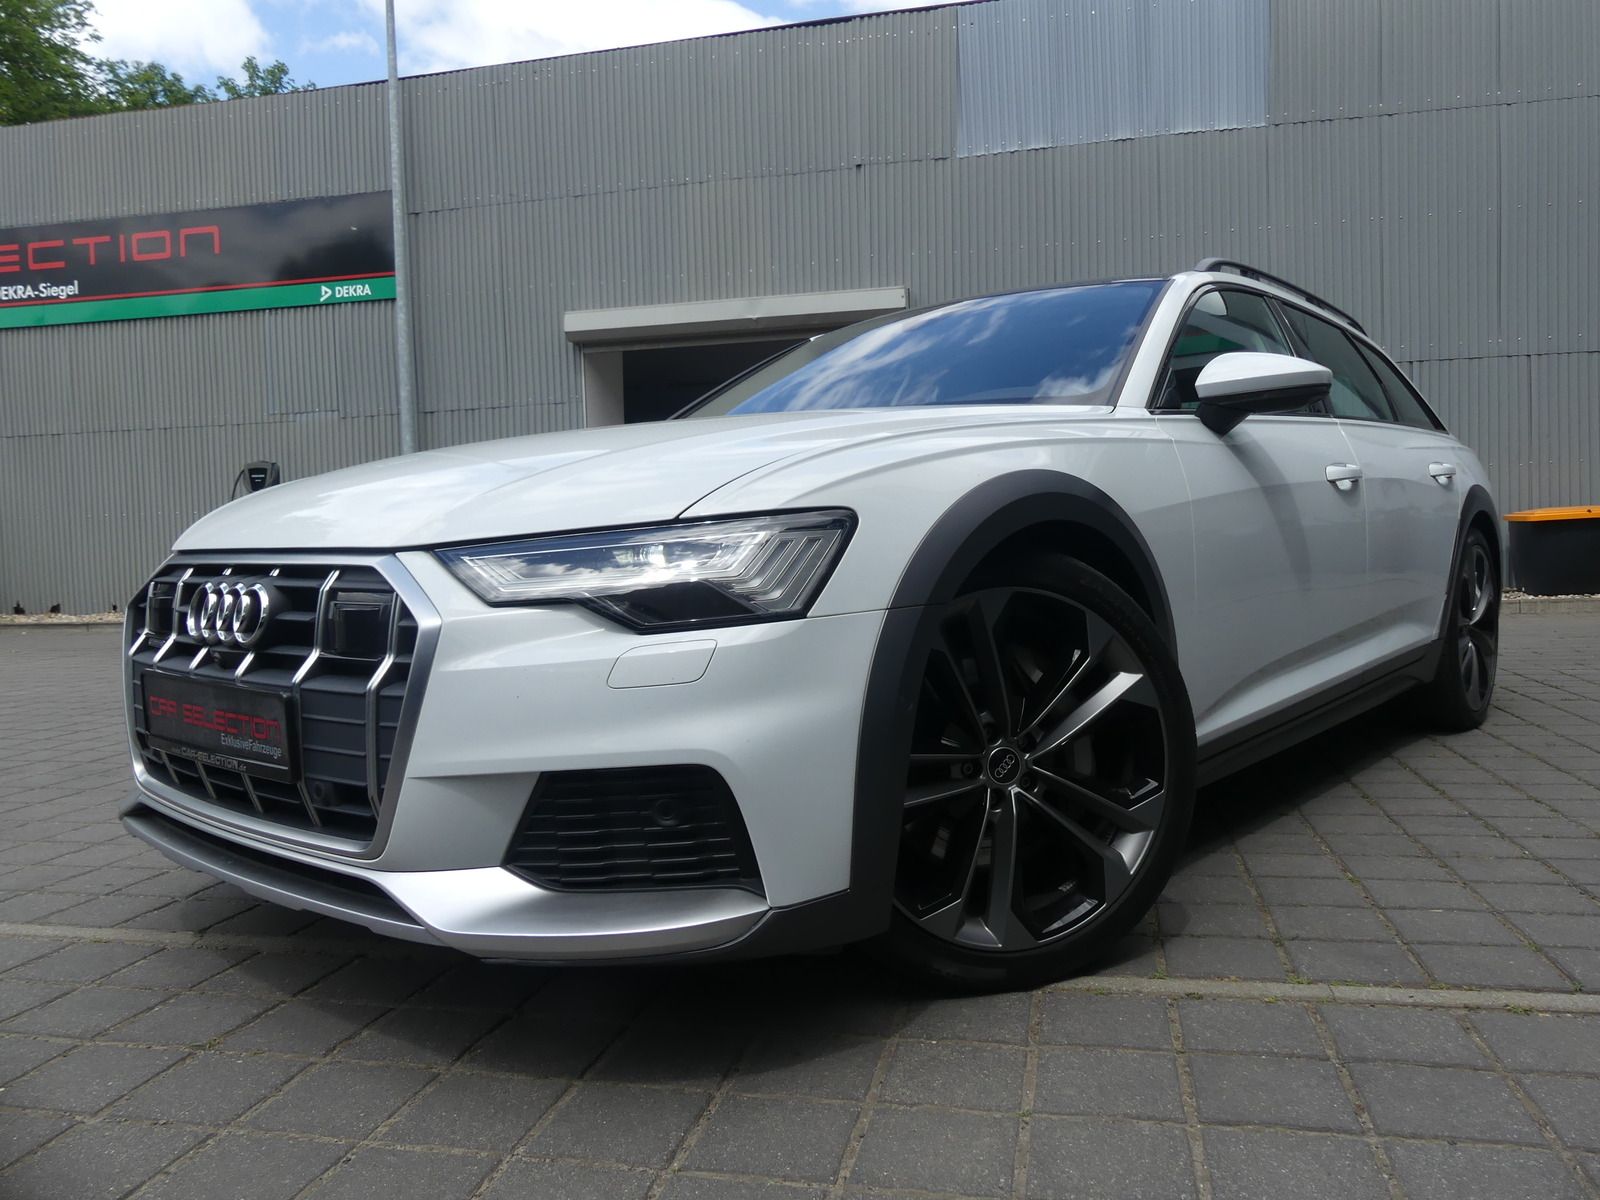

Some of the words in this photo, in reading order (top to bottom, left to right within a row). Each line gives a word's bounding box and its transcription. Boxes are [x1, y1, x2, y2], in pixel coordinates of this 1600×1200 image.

[0, 280, 79, 300] EKRA-Siegel
[335, 284, 371, 298] DEKRA
[150, 695, 179, 718] CAR
[182, 703, 281, 741] SELECTION
